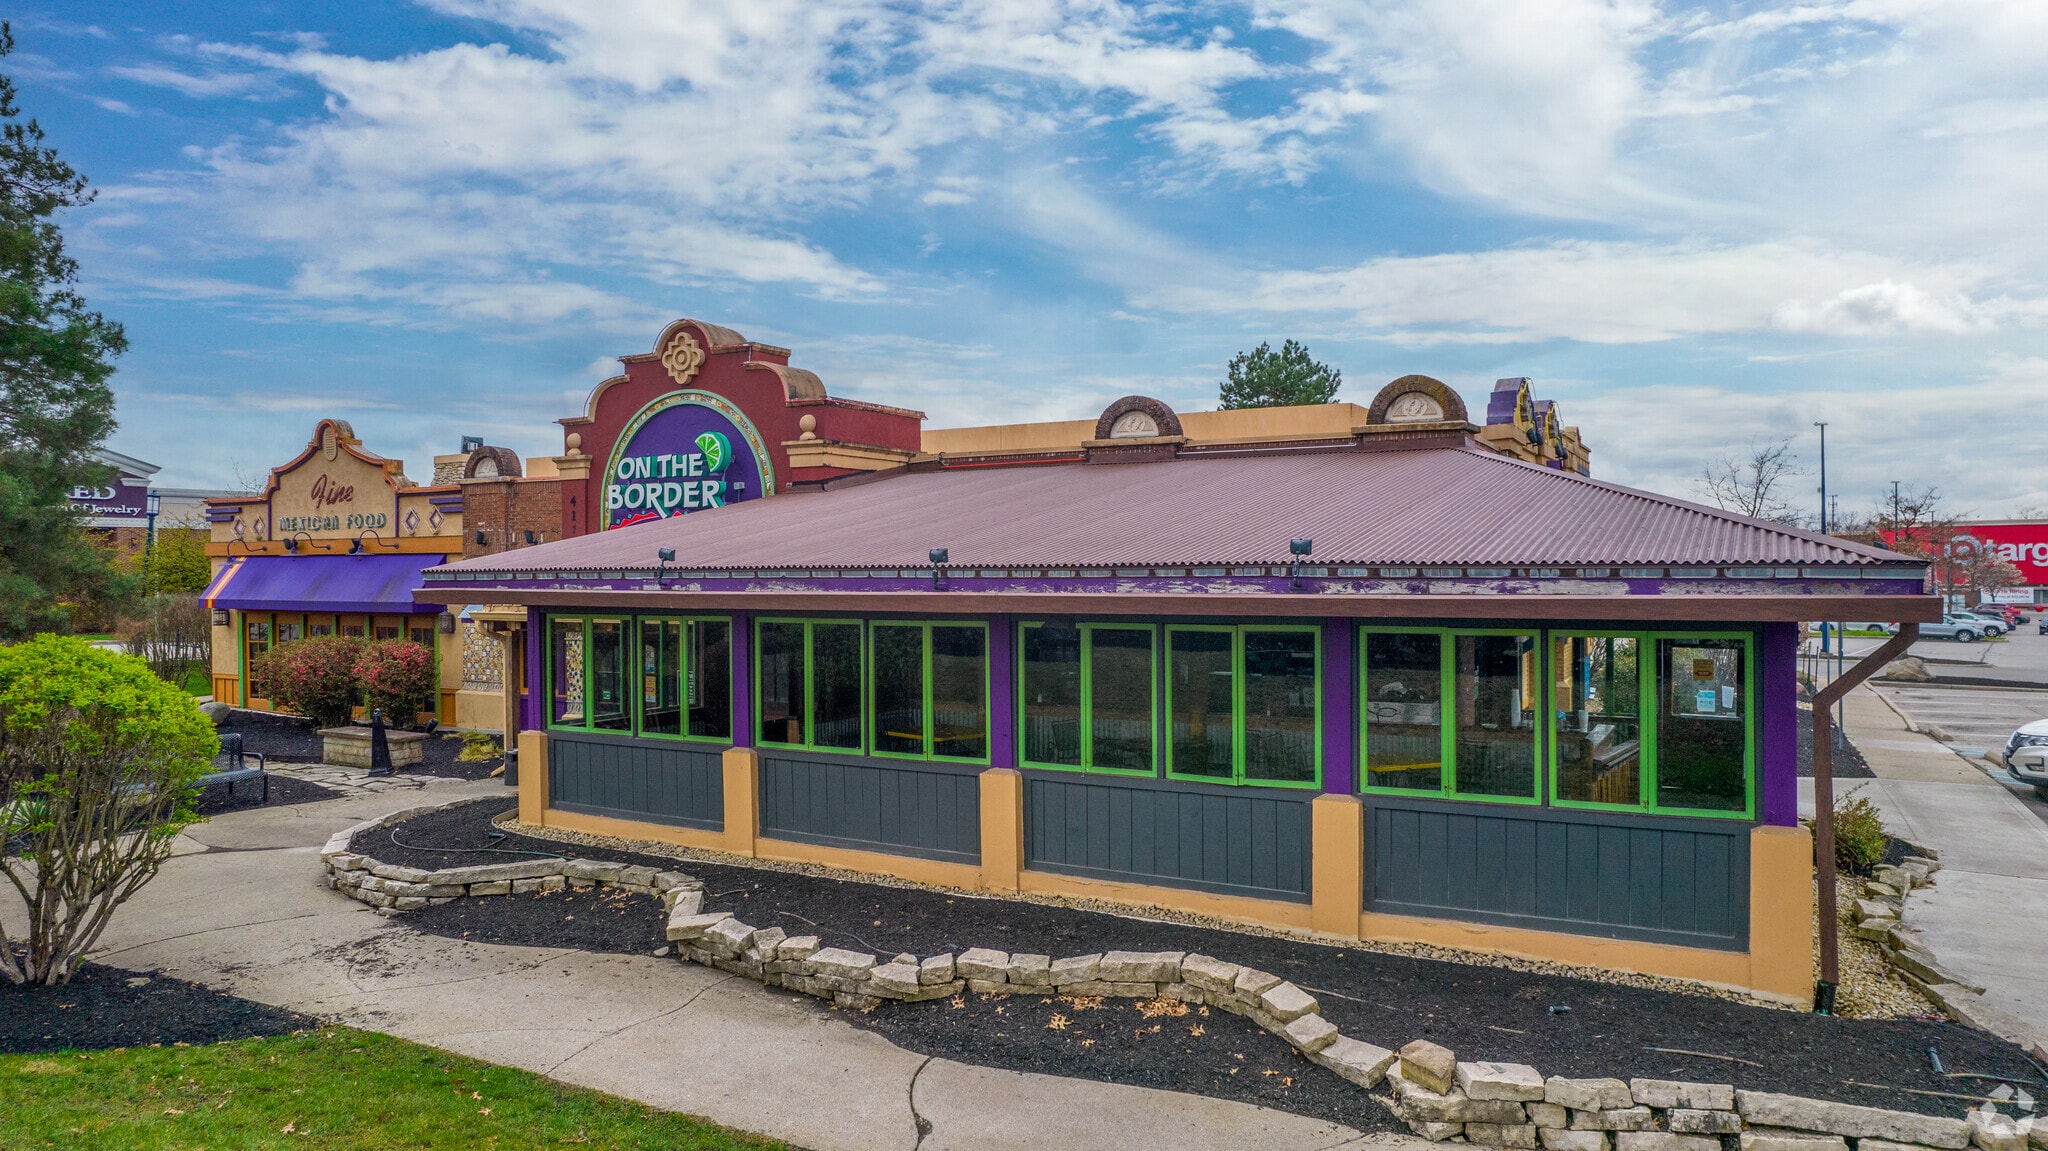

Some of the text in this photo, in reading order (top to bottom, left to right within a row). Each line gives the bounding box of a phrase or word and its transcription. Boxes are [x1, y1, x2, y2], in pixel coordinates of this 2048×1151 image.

[617, 453, 703, 480] ON THE
[64, 485, 116, 500] ED
[311, 474, 354, 509] Fine
[608, 480, 722, 519] BORDER
[89, 504, 142, 516] Jewelry
[280, 513, 387, 531] MEXICAN FOOD
